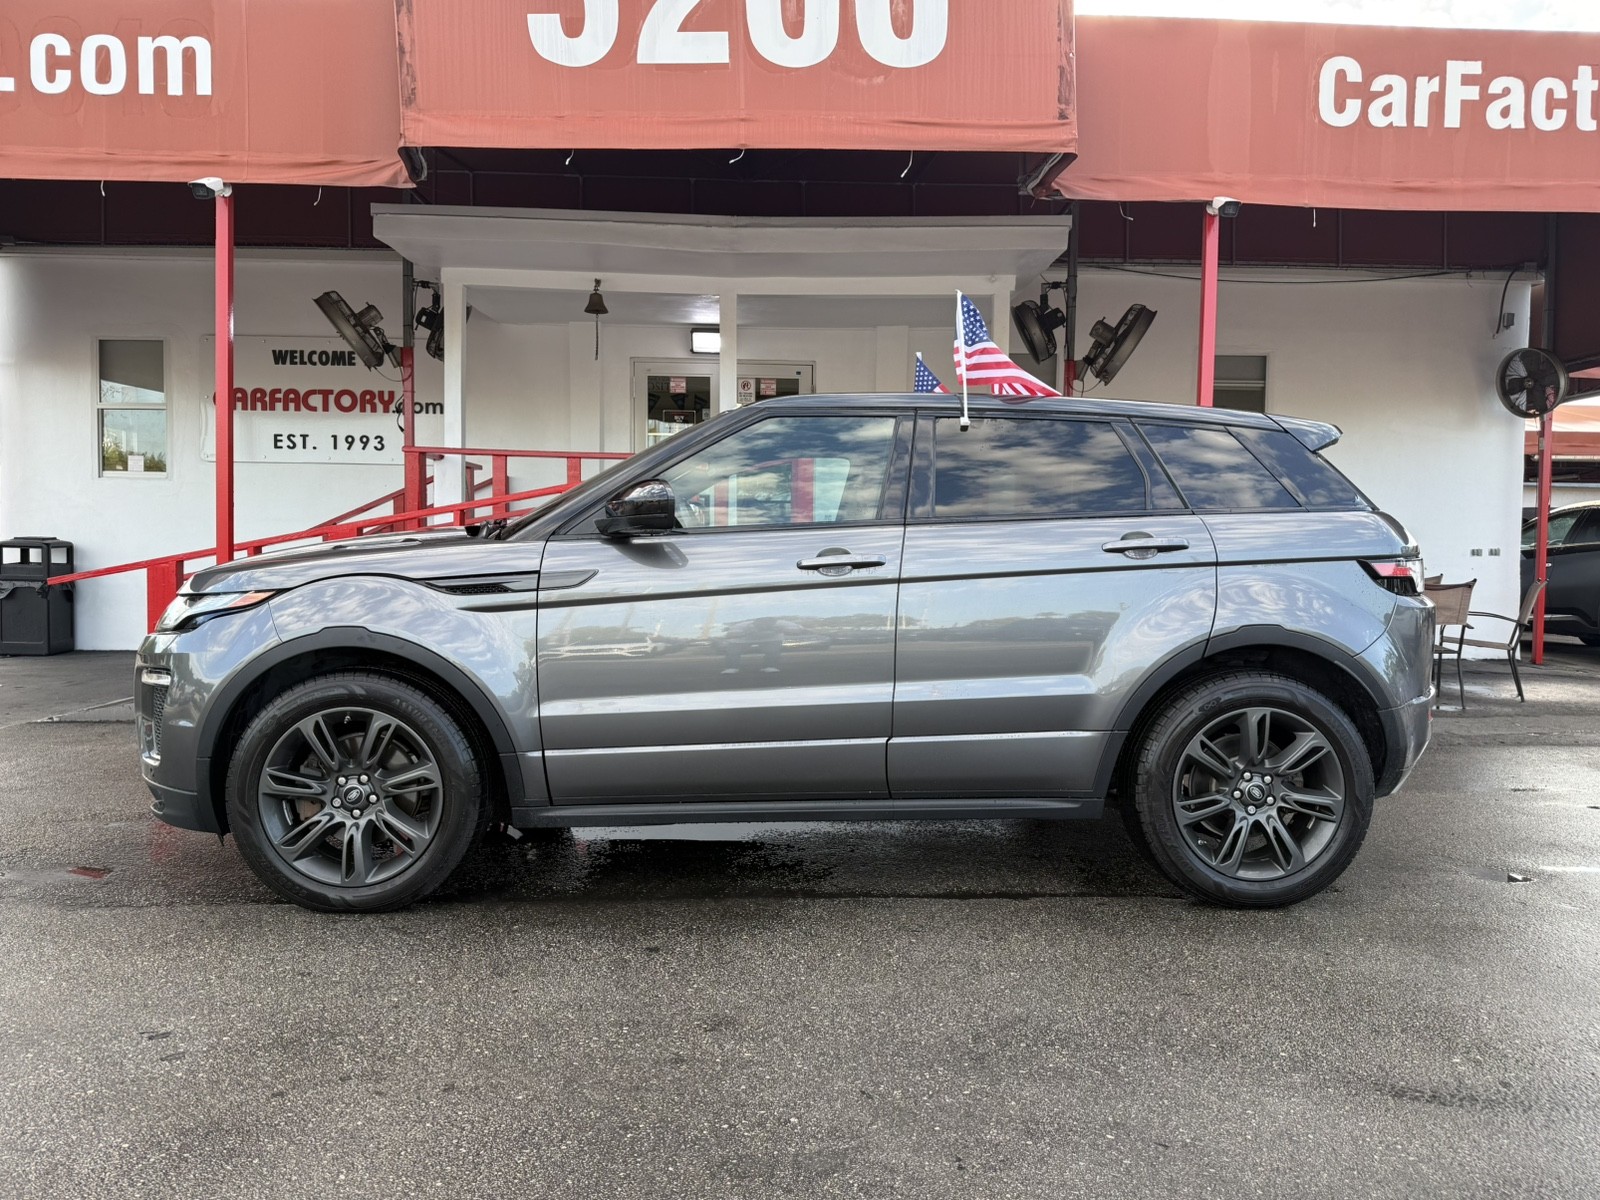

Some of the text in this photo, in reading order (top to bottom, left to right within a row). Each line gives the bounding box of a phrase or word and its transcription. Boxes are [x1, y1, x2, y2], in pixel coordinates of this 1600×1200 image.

[1318, 55, 1599, 132] CarFact
[272, 349, 356, 366] WELCOME
[273, 433, 385, 451] EST. 1993
